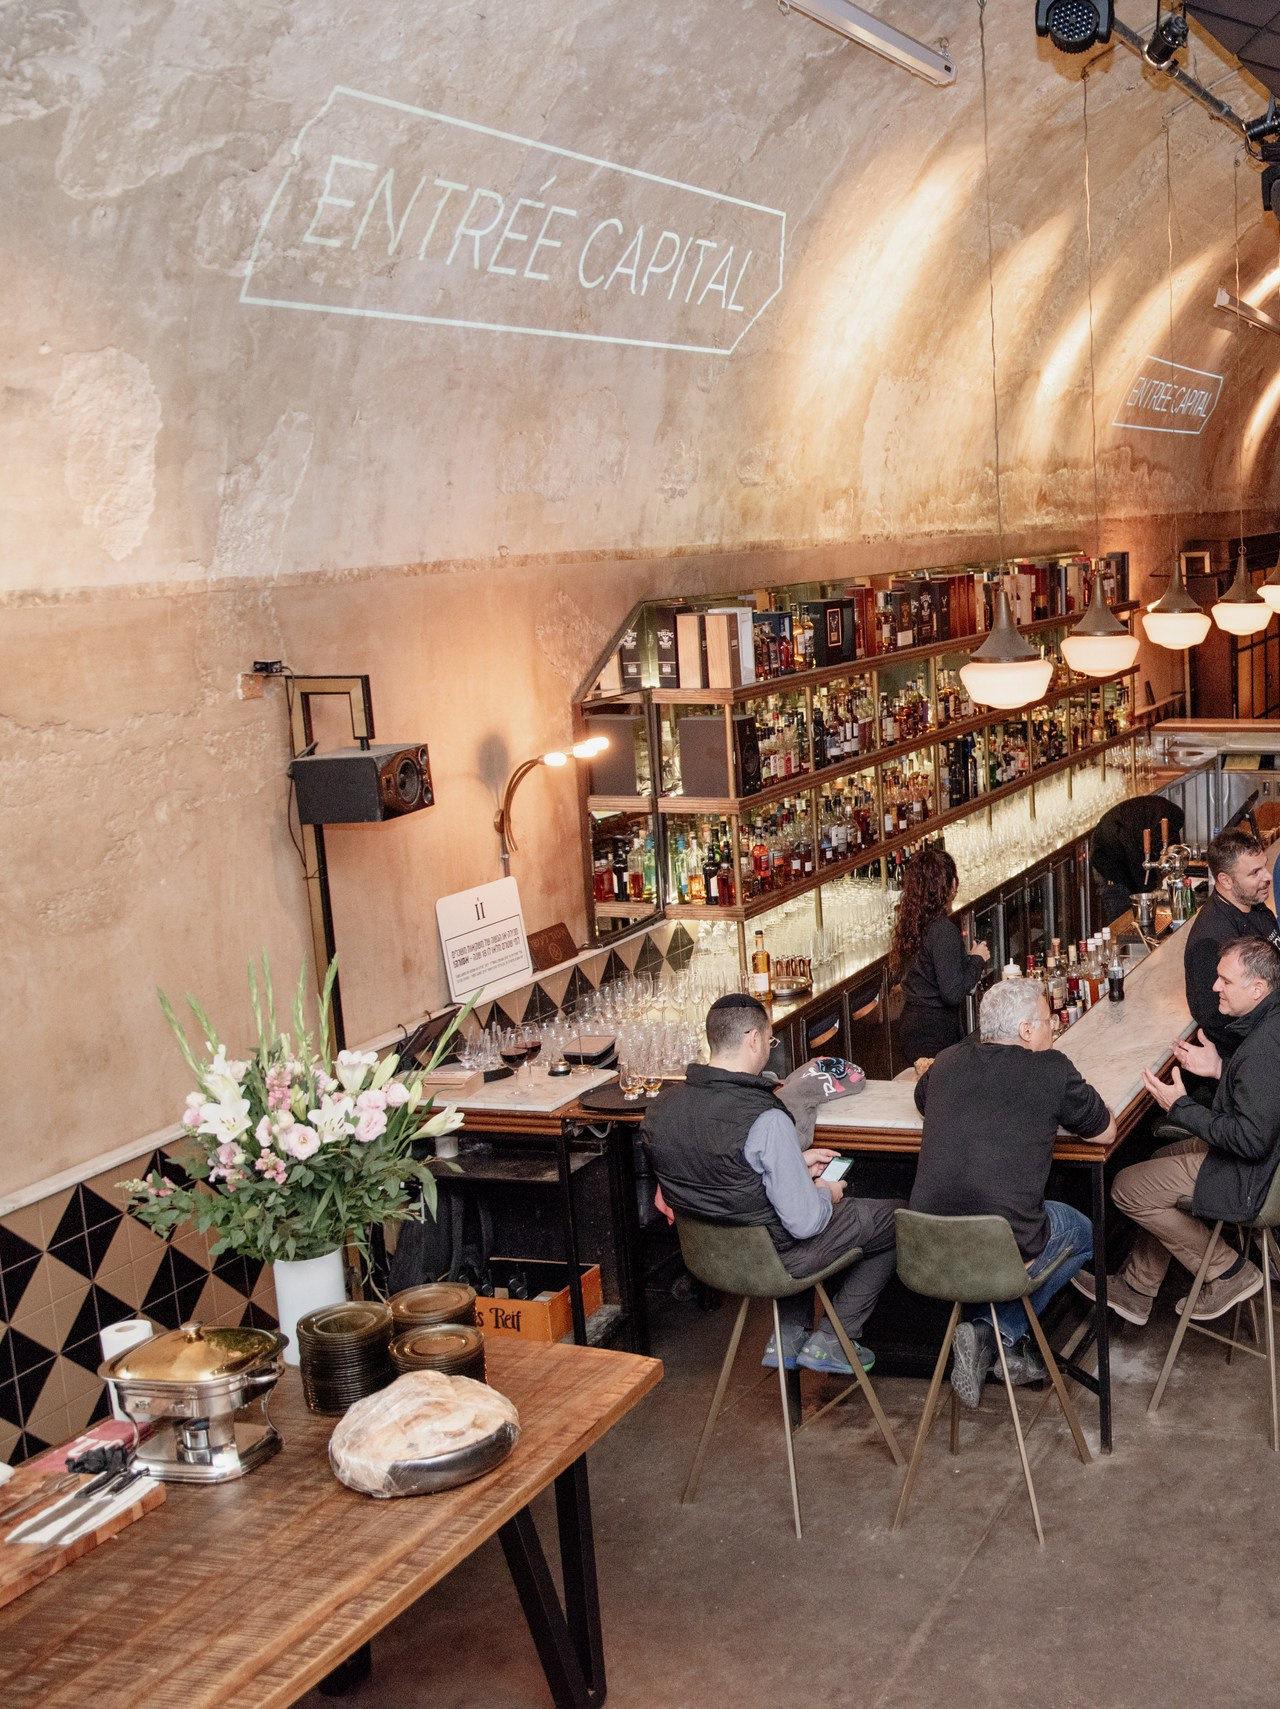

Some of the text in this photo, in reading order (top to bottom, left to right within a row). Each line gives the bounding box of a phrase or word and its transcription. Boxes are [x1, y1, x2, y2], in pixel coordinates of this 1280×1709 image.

[302, 155, 753, 312] ENTRÉE CAPITAL
[1126, 374, 1213, 417] ENTRÉE CAPITAL
[489, 1307, 522, 1332] Reif
